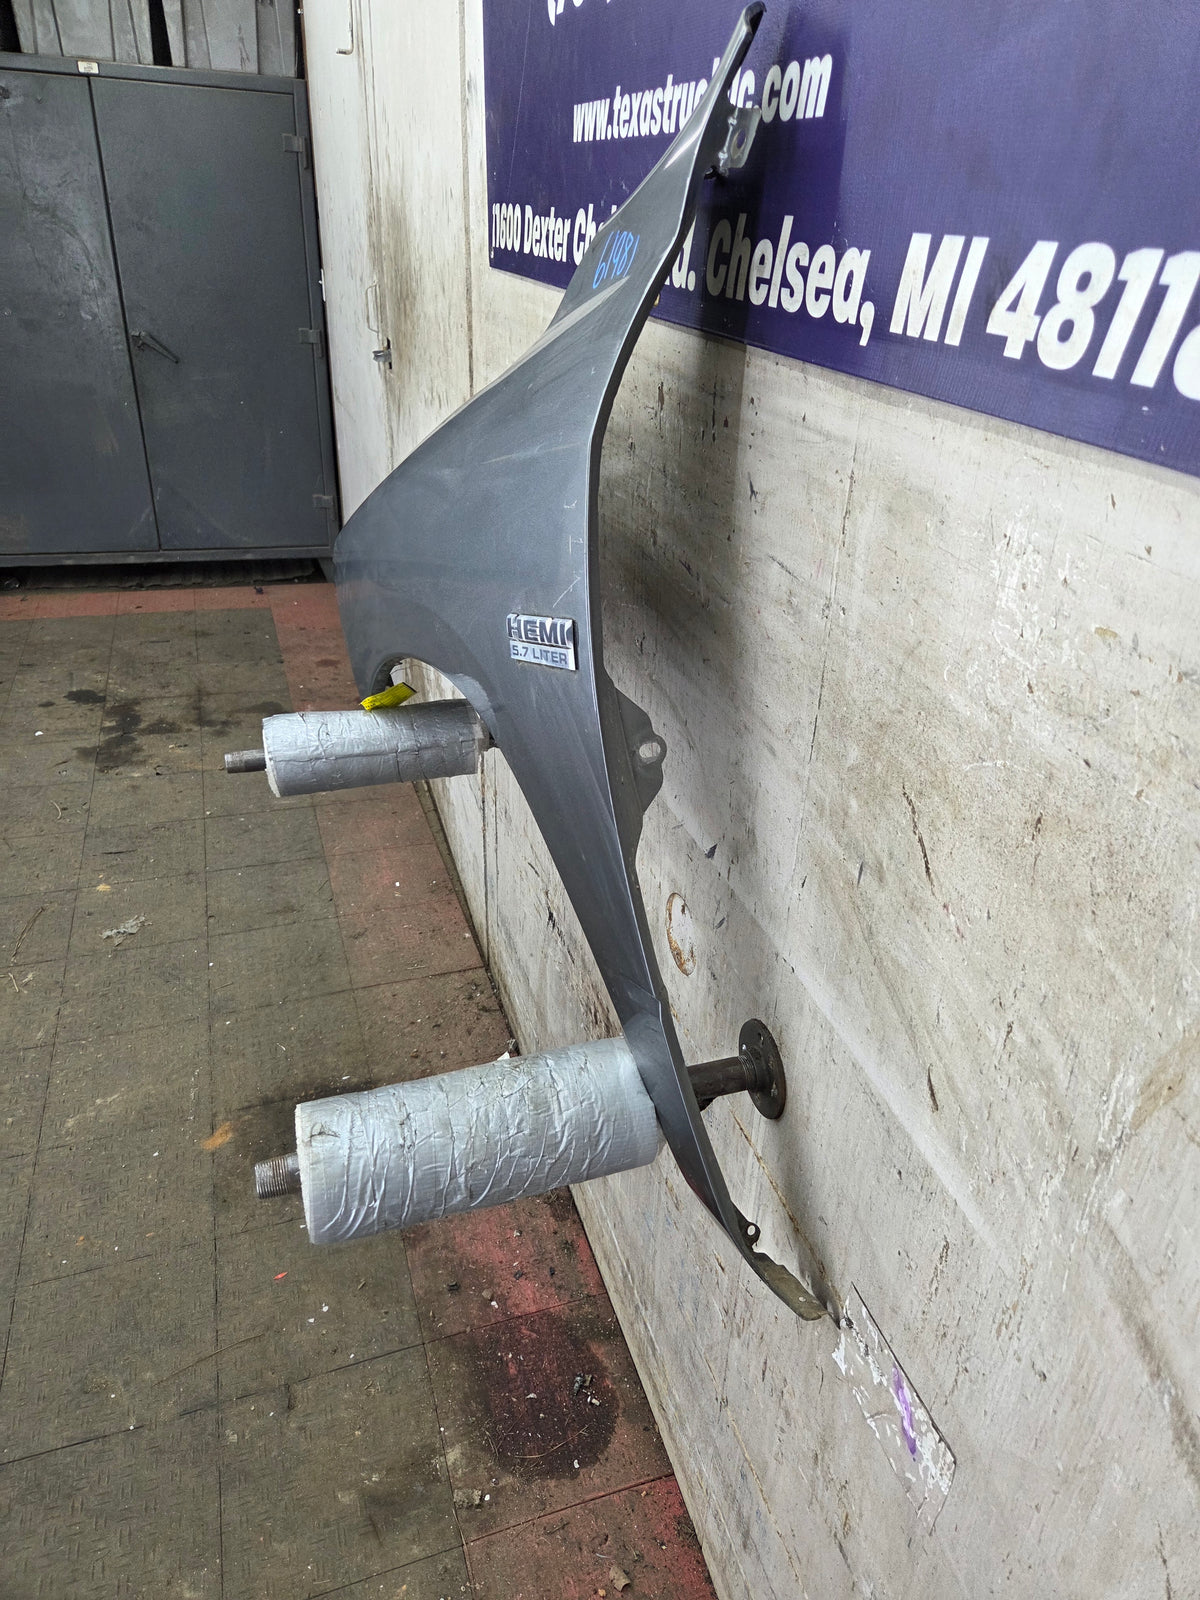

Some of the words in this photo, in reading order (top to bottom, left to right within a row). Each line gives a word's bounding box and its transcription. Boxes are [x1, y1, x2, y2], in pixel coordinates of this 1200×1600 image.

[492, 202, 521, 253] 11600
[523, 204, 571, 263] Dexter
[706, 213, 875, 347] Chelsea,
[889, 232, 990, 347] MI
[506, 613, 570, 648] HEMI
[511, 644, 529, 658] 5.7
[532, 647, 568, 666] LITER
